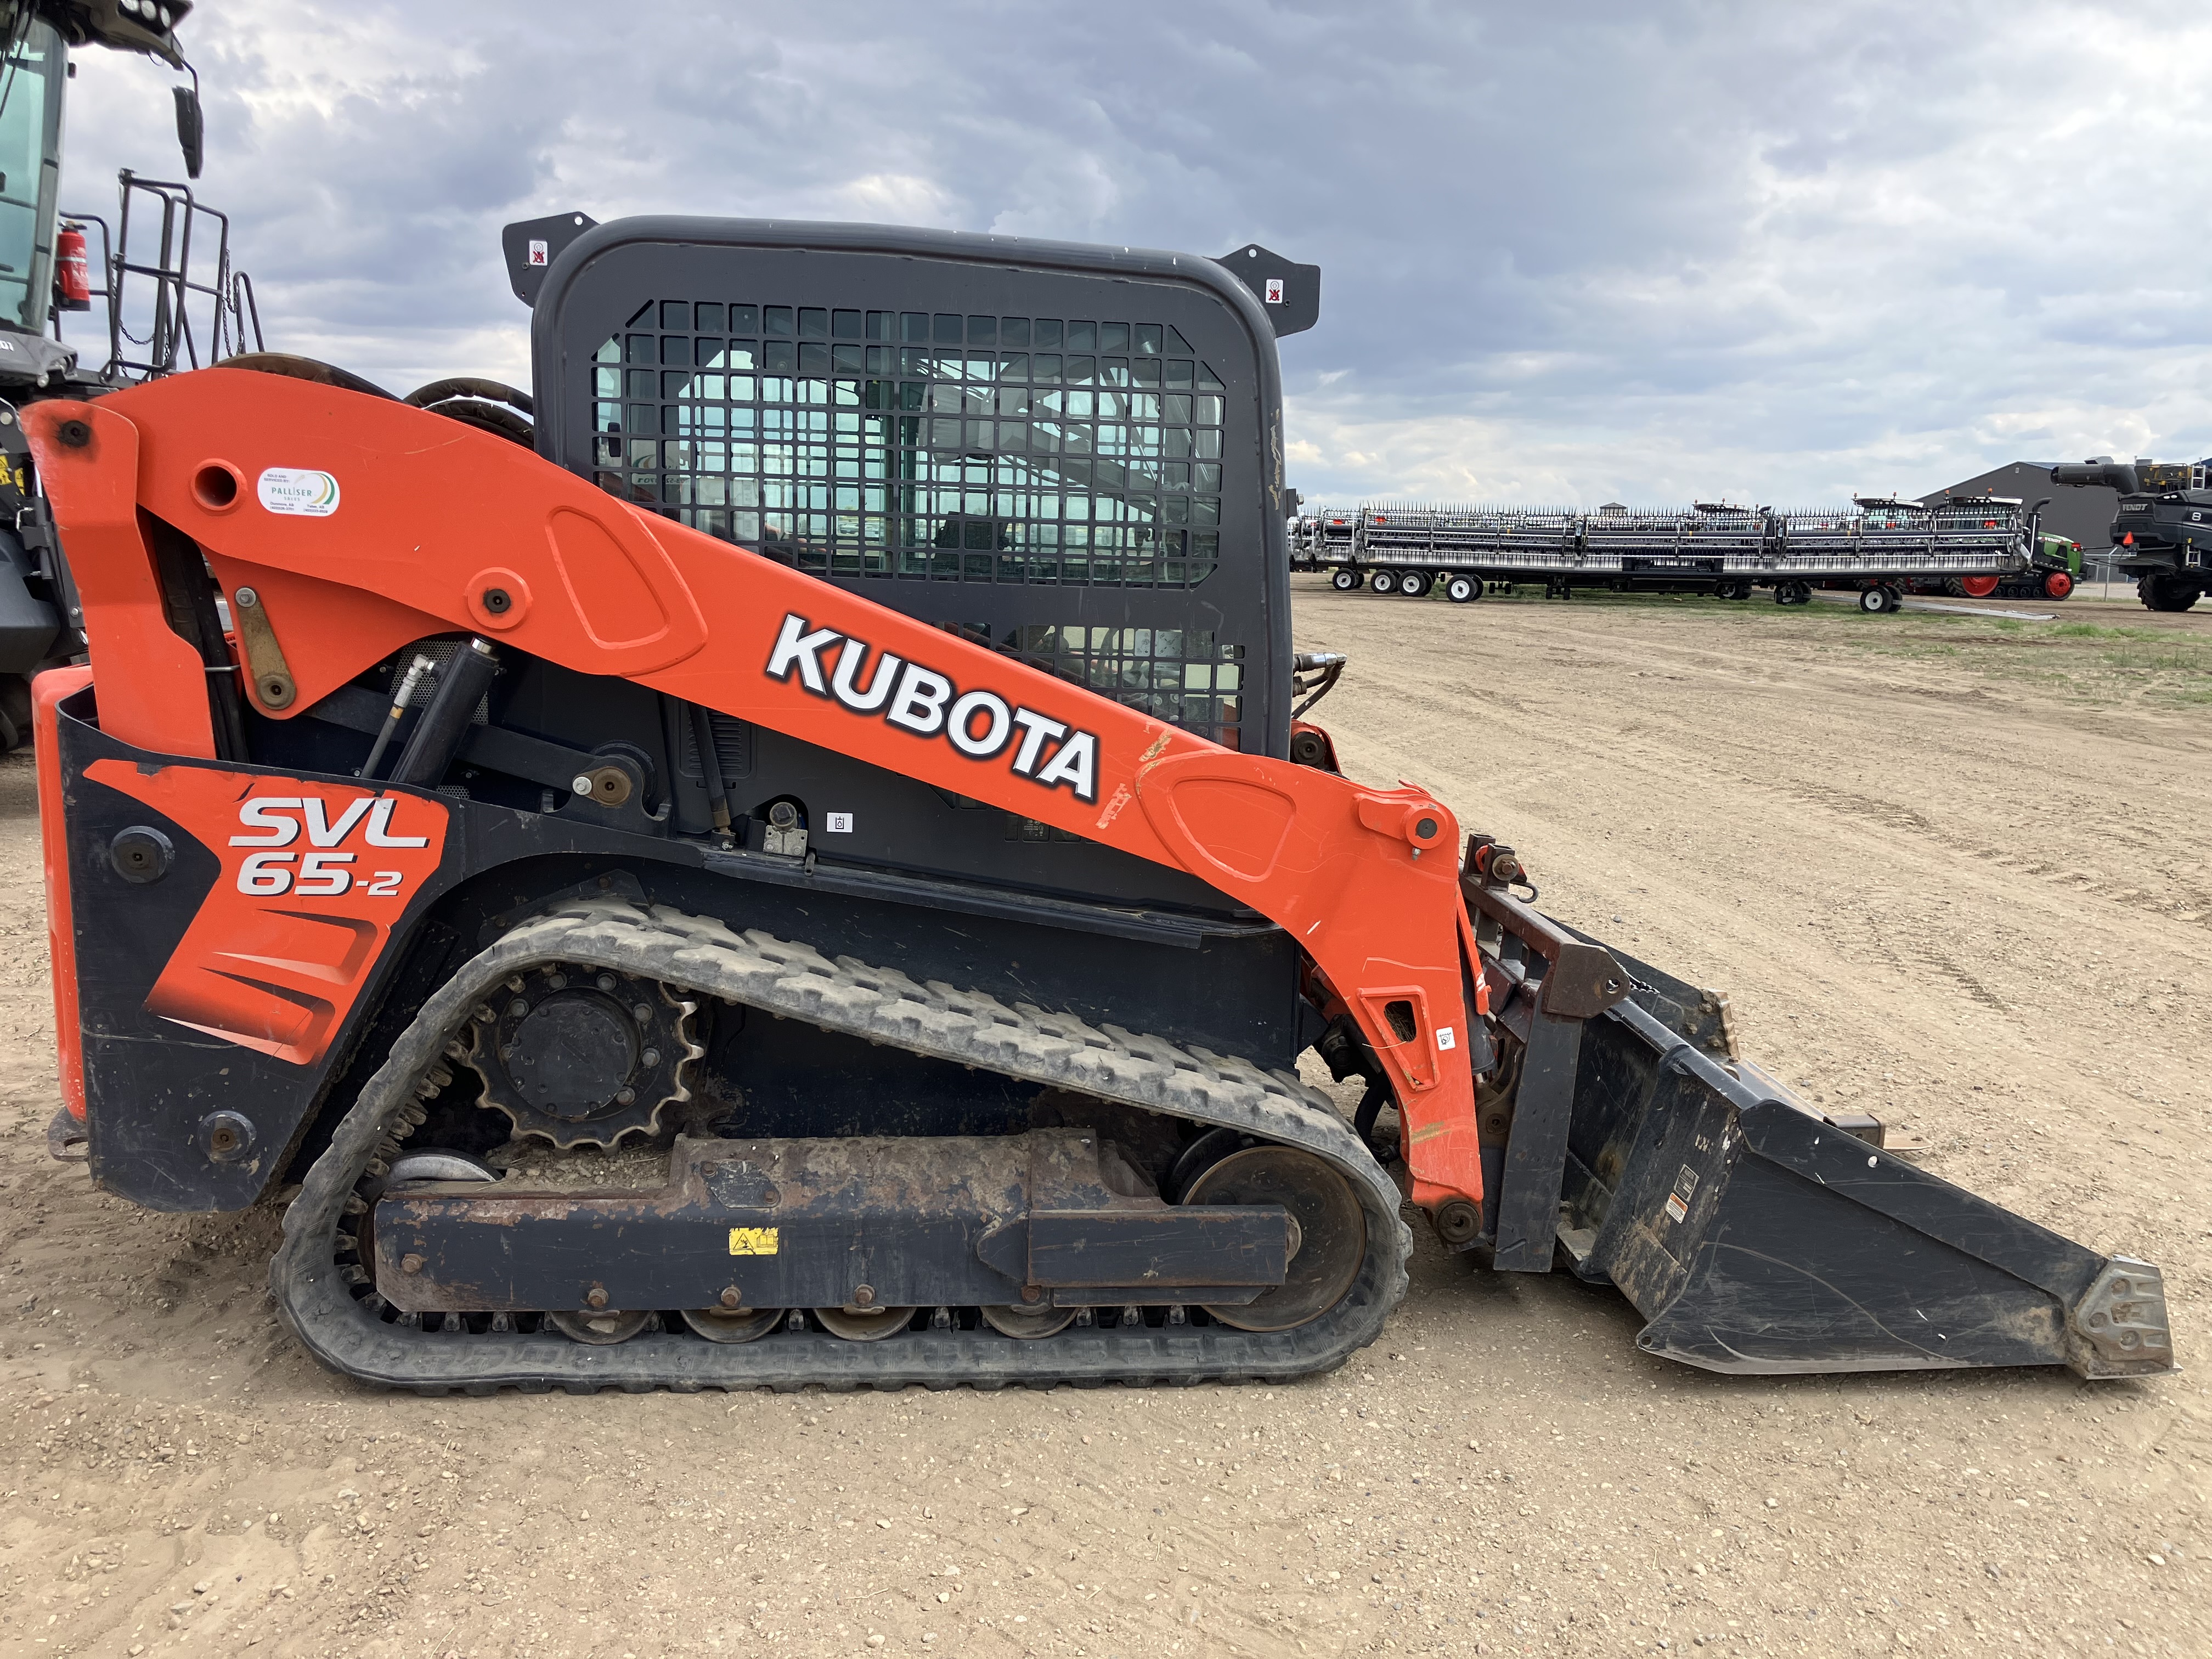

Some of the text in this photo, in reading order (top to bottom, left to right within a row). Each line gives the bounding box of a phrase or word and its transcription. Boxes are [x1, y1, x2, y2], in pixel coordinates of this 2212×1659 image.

[272, 487, 312, 496] PALLISER
[2192, 512, 2201, 521] 8
[766, 613, 1097, 801] KUBOTA
[228, 797, 430, 848] SVL
[237, 852, 403, 896] 65-2
